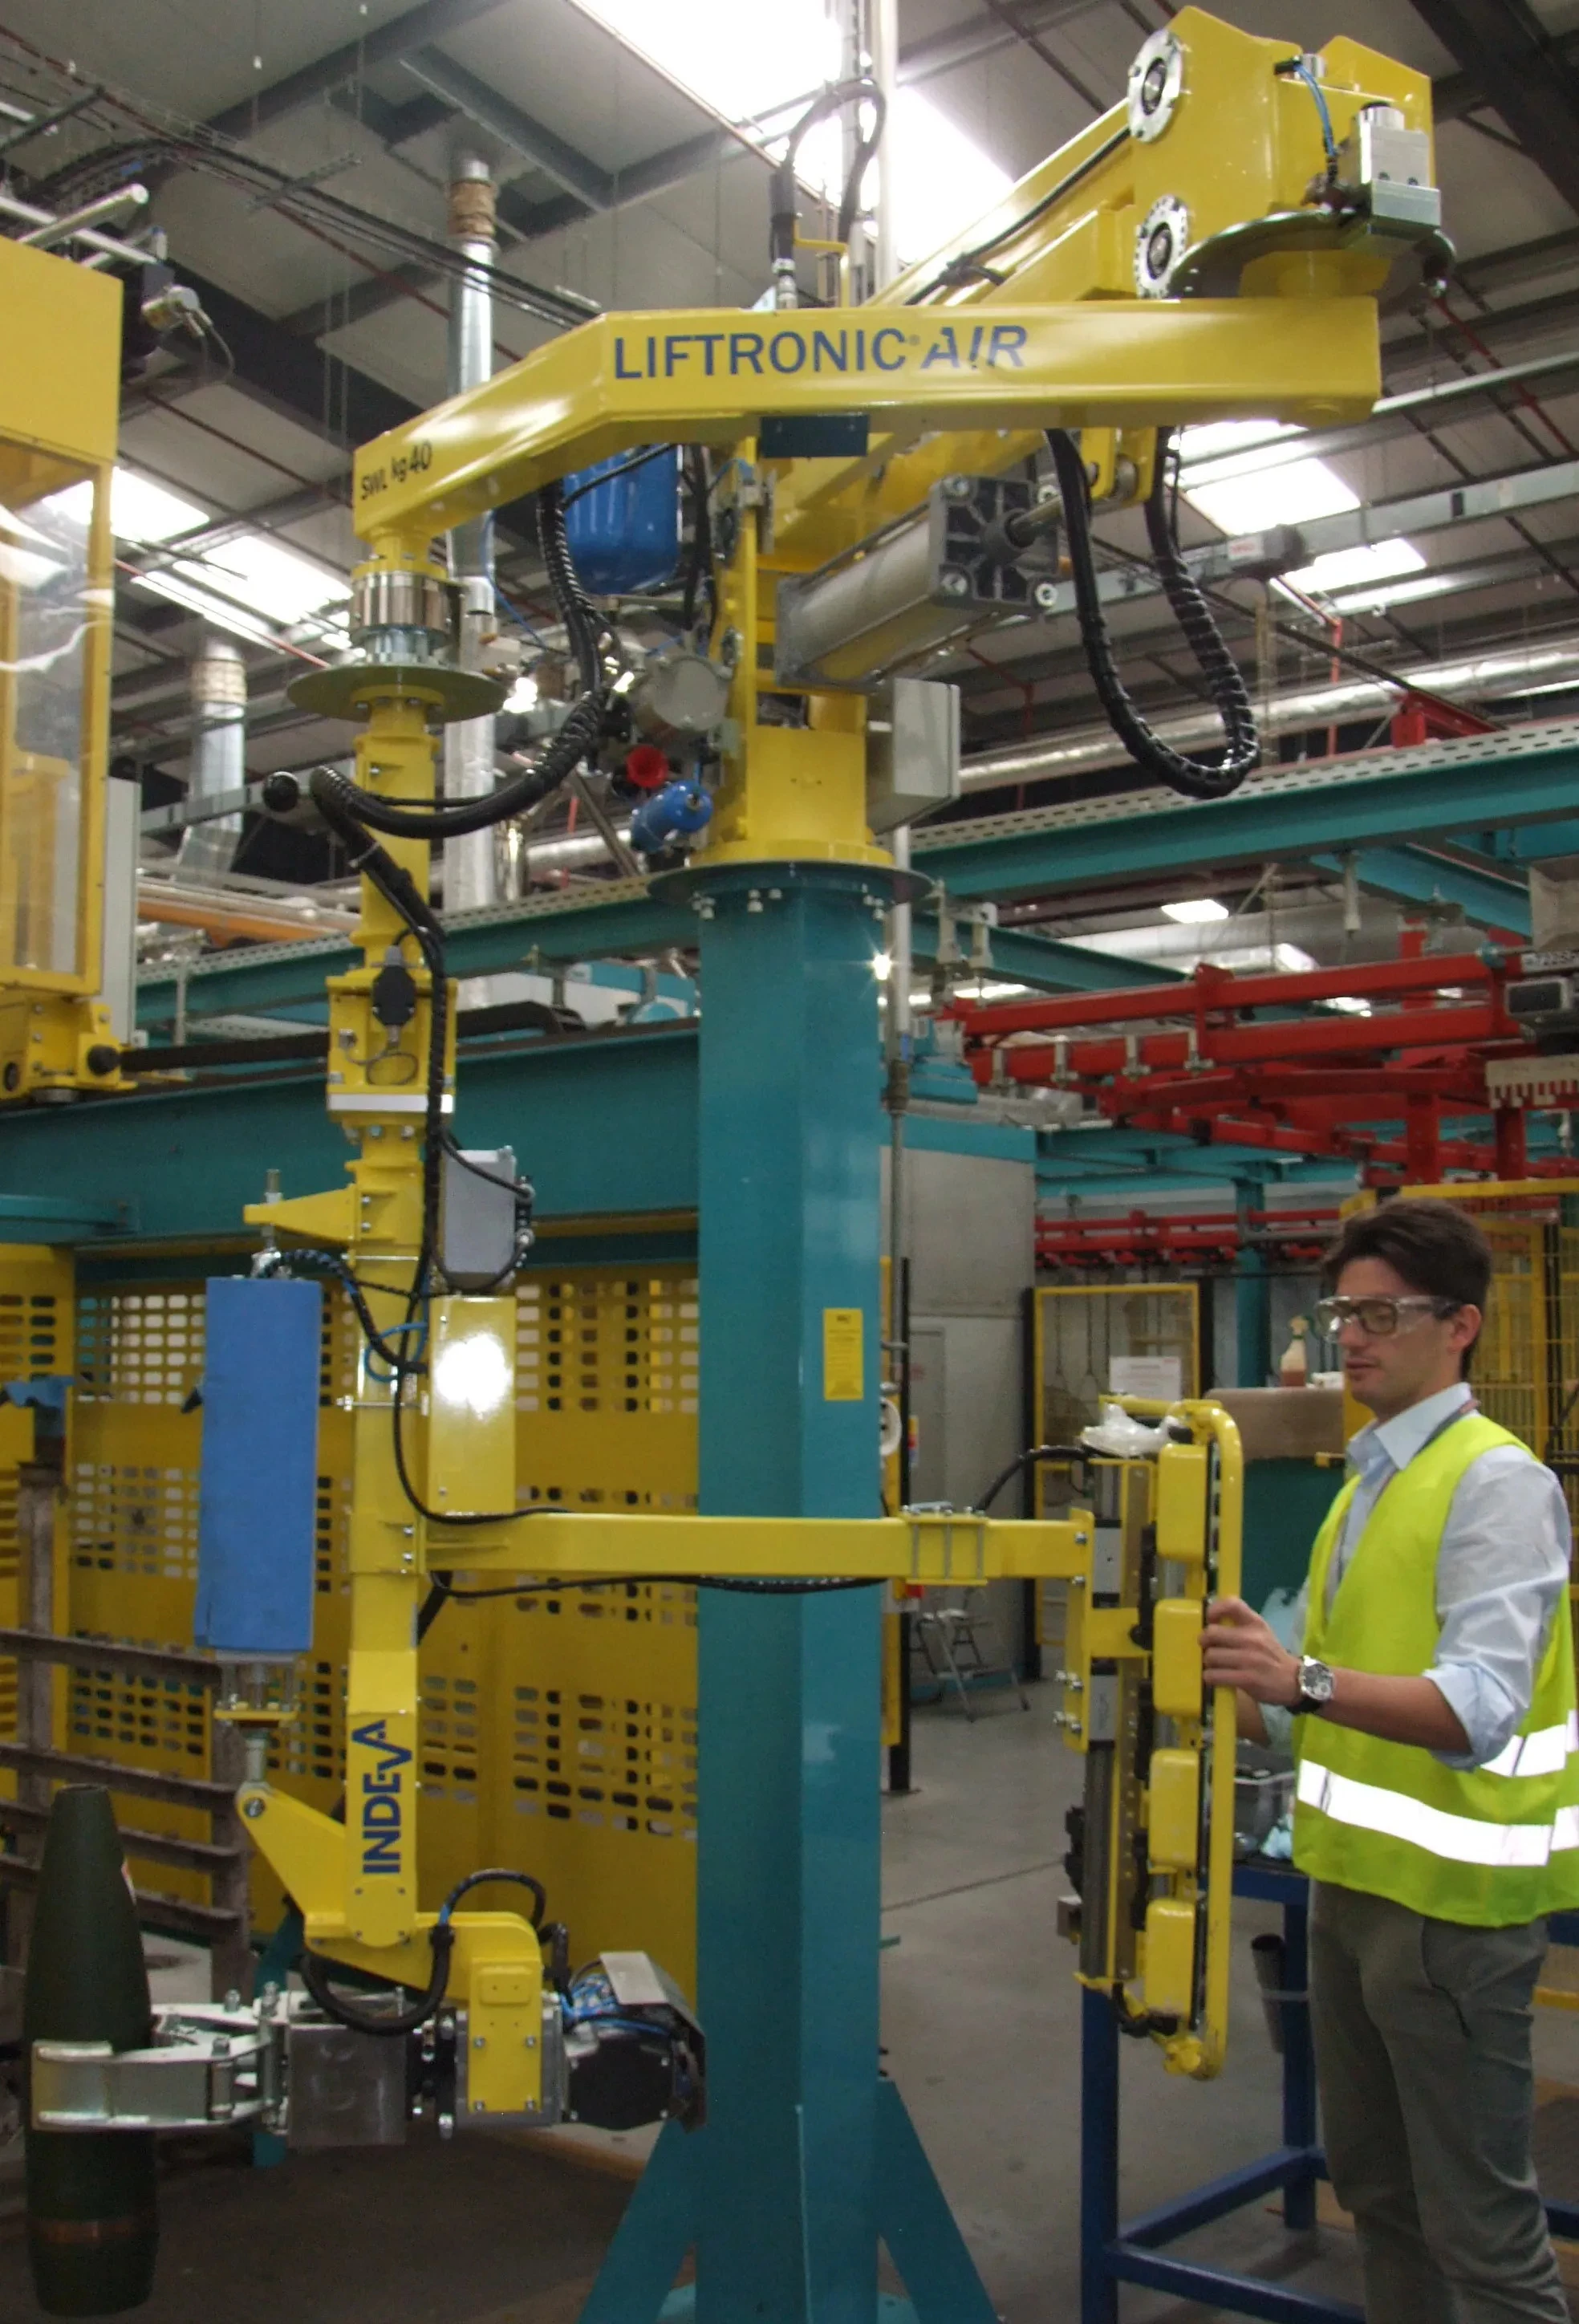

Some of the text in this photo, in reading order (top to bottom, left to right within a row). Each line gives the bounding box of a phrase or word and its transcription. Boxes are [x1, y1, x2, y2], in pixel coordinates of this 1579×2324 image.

[360, 465, 388, 501] SWL
[409, 439, 432, 473] 40
[351, 1719, 413, 1875] INDEVA
